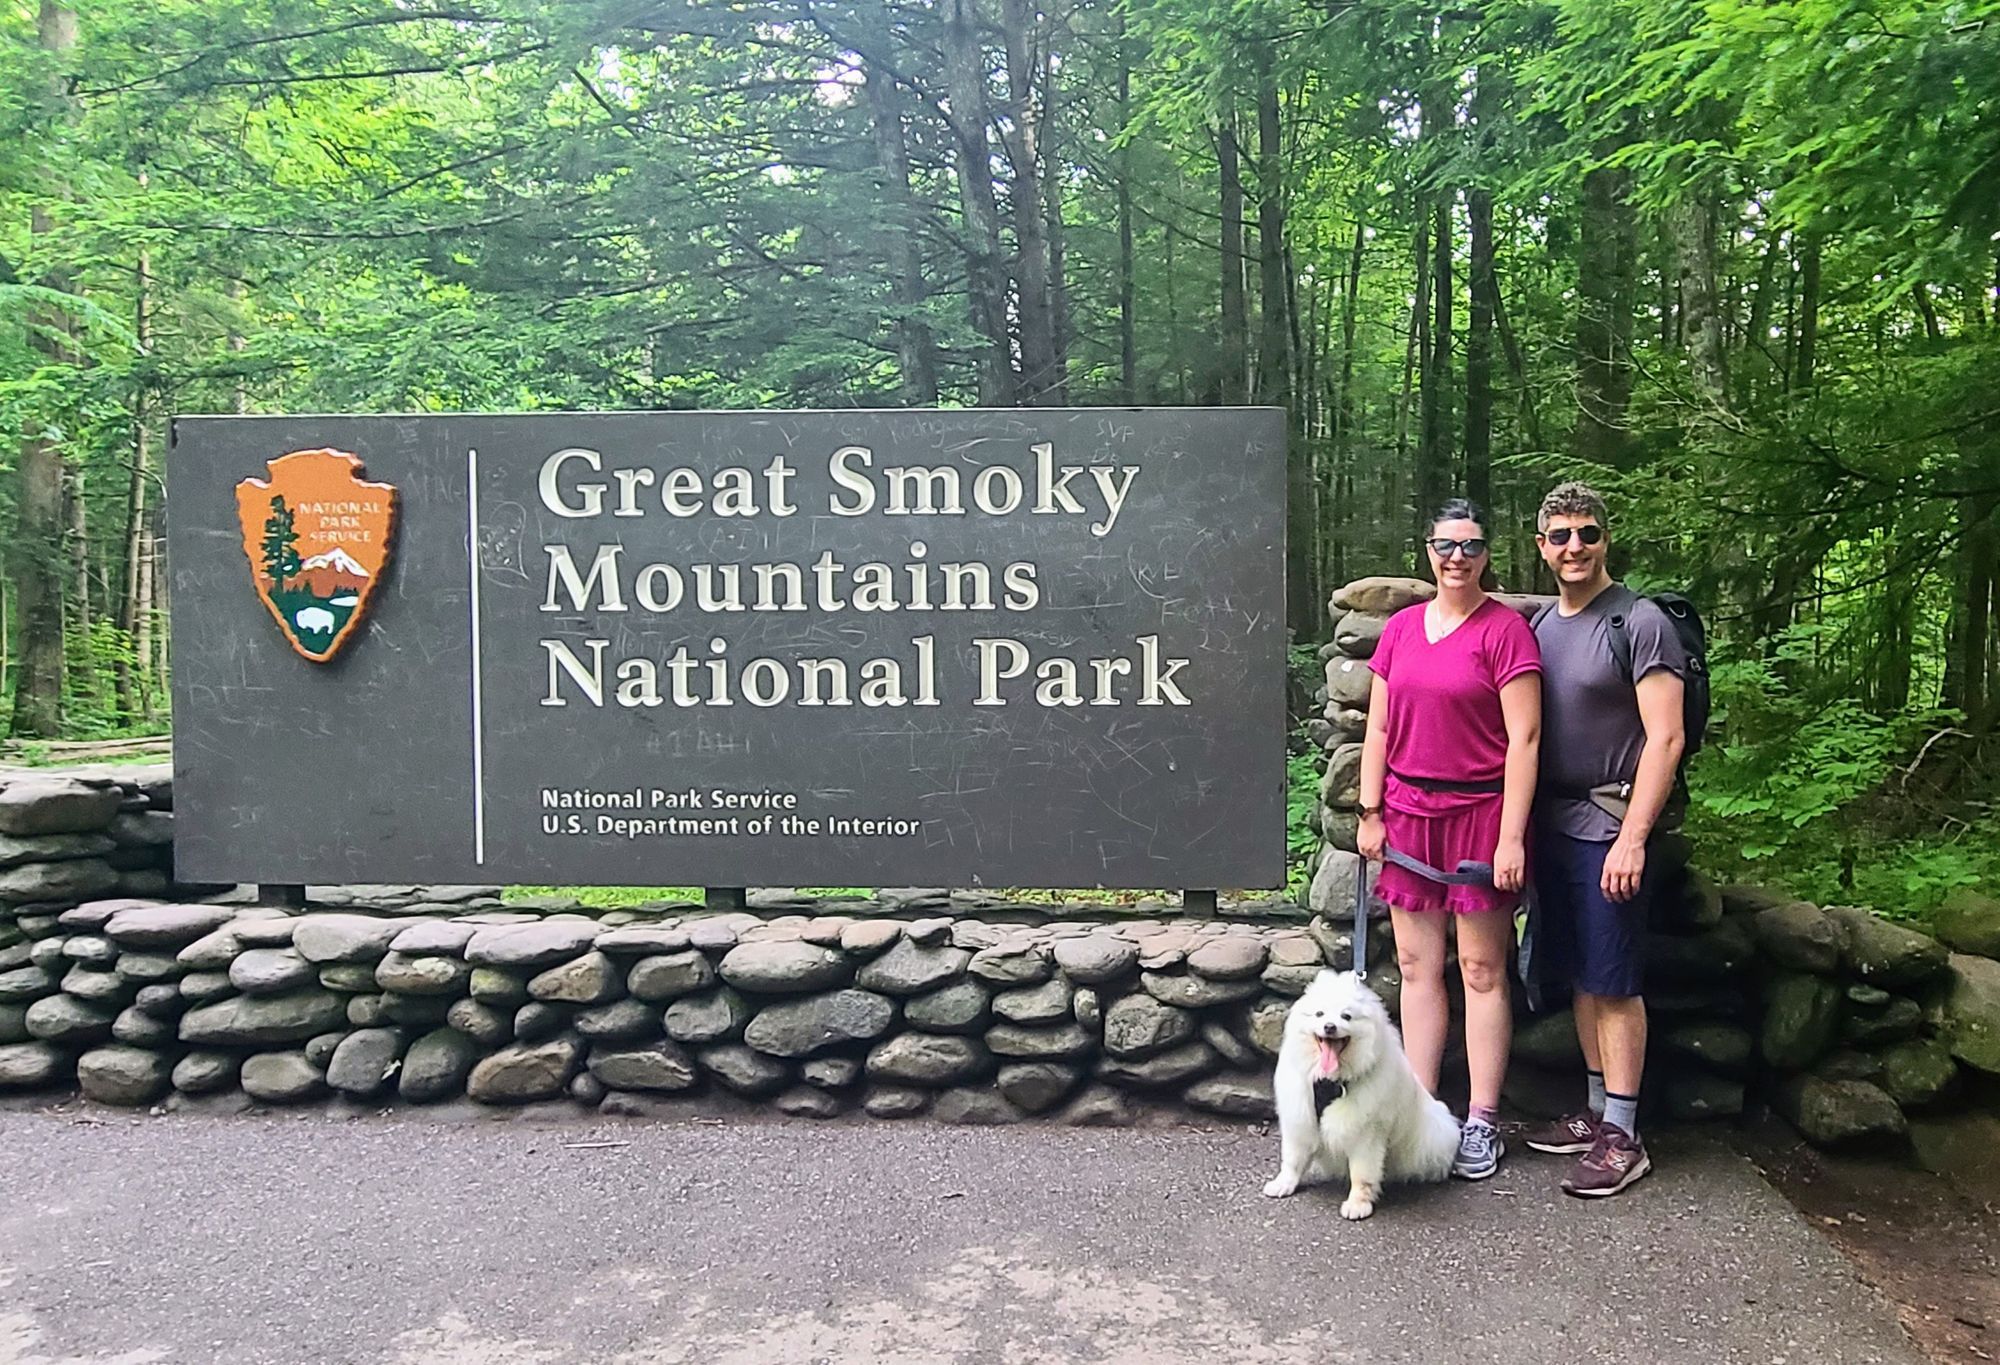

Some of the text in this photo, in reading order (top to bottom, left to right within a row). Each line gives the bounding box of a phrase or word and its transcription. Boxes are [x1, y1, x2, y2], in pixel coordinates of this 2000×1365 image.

[538, 442, 1140, 538] Great Smoky
[299, 502, 380, 514] NATIONAL
[320, 516, 361, 528] PARK
[309, 530, 372, 543] SERVICE
[539, 541, 1039, 613] Mountains
[540, 635, 1192, 707] National Park
[542, 788, 797, 809] National Park Service
[542, 815, 920, 839] U.S. Department of the Interior
